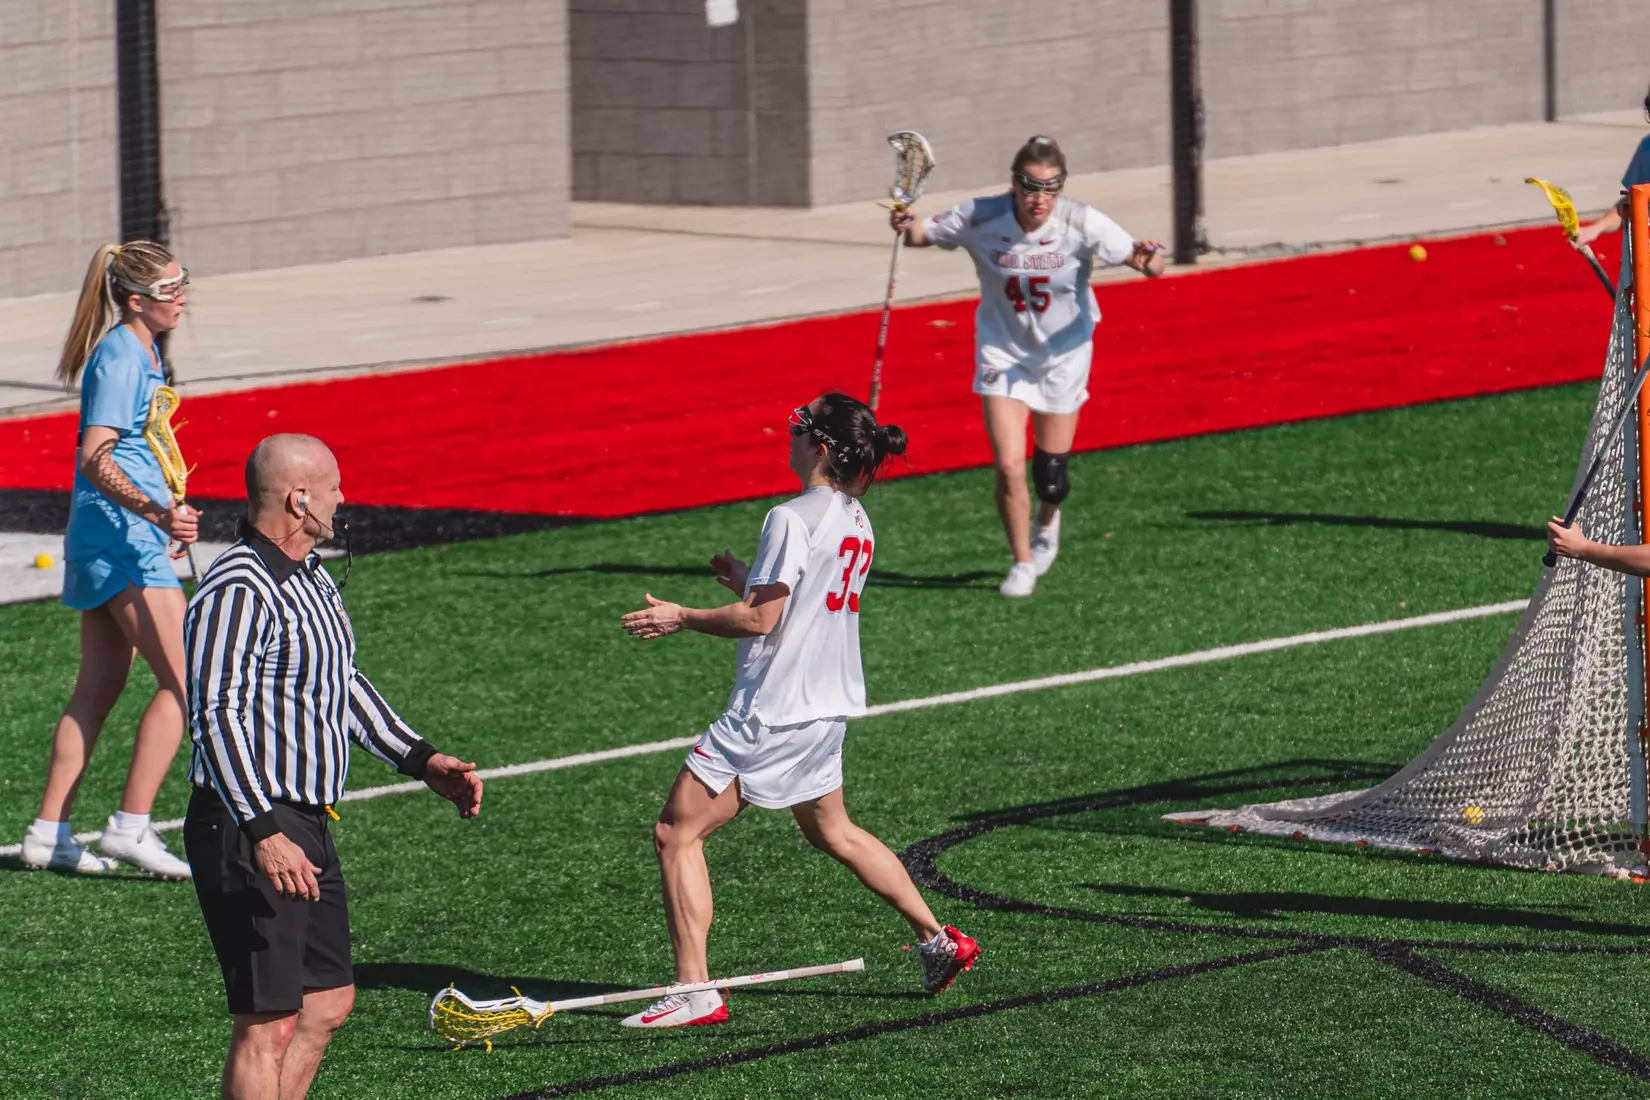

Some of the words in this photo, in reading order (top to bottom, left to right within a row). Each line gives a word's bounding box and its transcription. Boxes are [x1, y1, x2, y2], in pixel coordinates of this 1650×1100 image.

[989, 250, 1019, 269] OO
[1023, 252, 1065, 270] STATE
[1004, 275, 1051, 312] 45
[812, 428, 838, 446] STX
